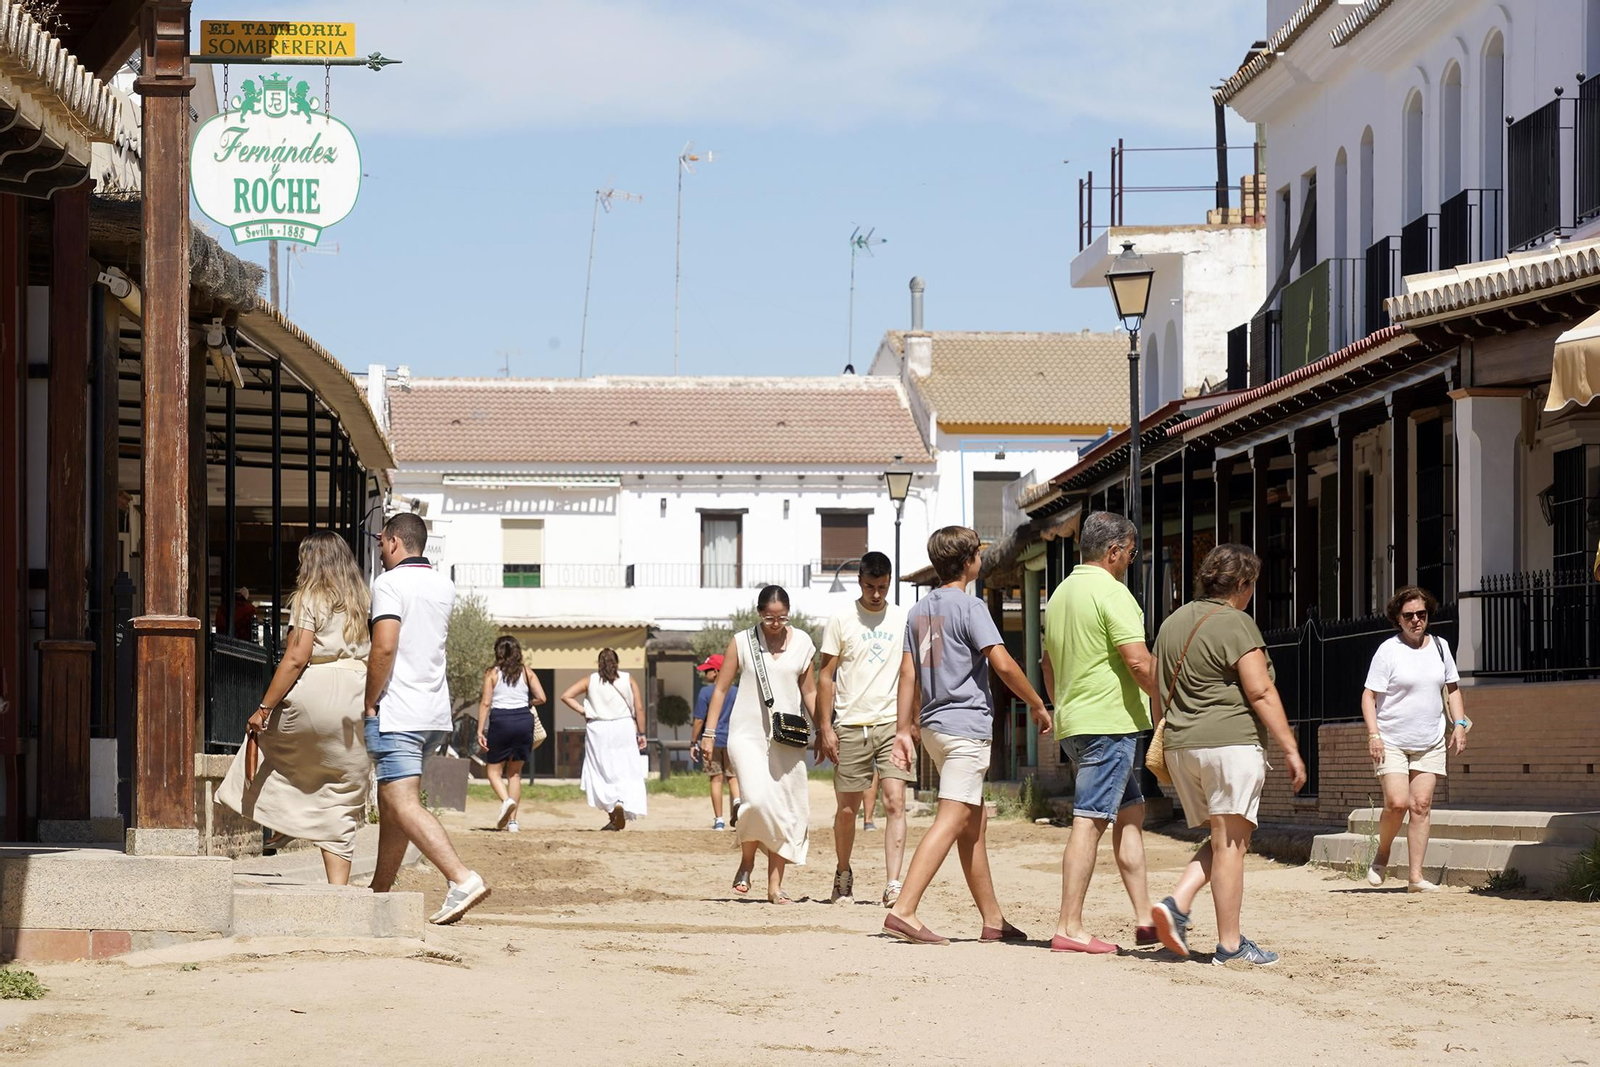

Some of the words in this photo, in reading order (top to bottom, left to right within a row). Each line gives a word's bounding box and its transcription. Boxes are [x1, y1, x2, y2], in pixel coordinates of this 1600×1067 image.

[208, 23, 235, 36] EL
[241, 23, 347, 37] TAMBORIL
[208, 38, 348, 55] SOMBRERERIA
[214, 126, 338, 164] Fernández
[269, 163, 282, 181] y
[233, 178, 321, 214] ROCHE
[245, 224, 273, 238] Sevilla
[283, 225, 305, 239] 1885
[861, 631, 894, 641] HARPER
